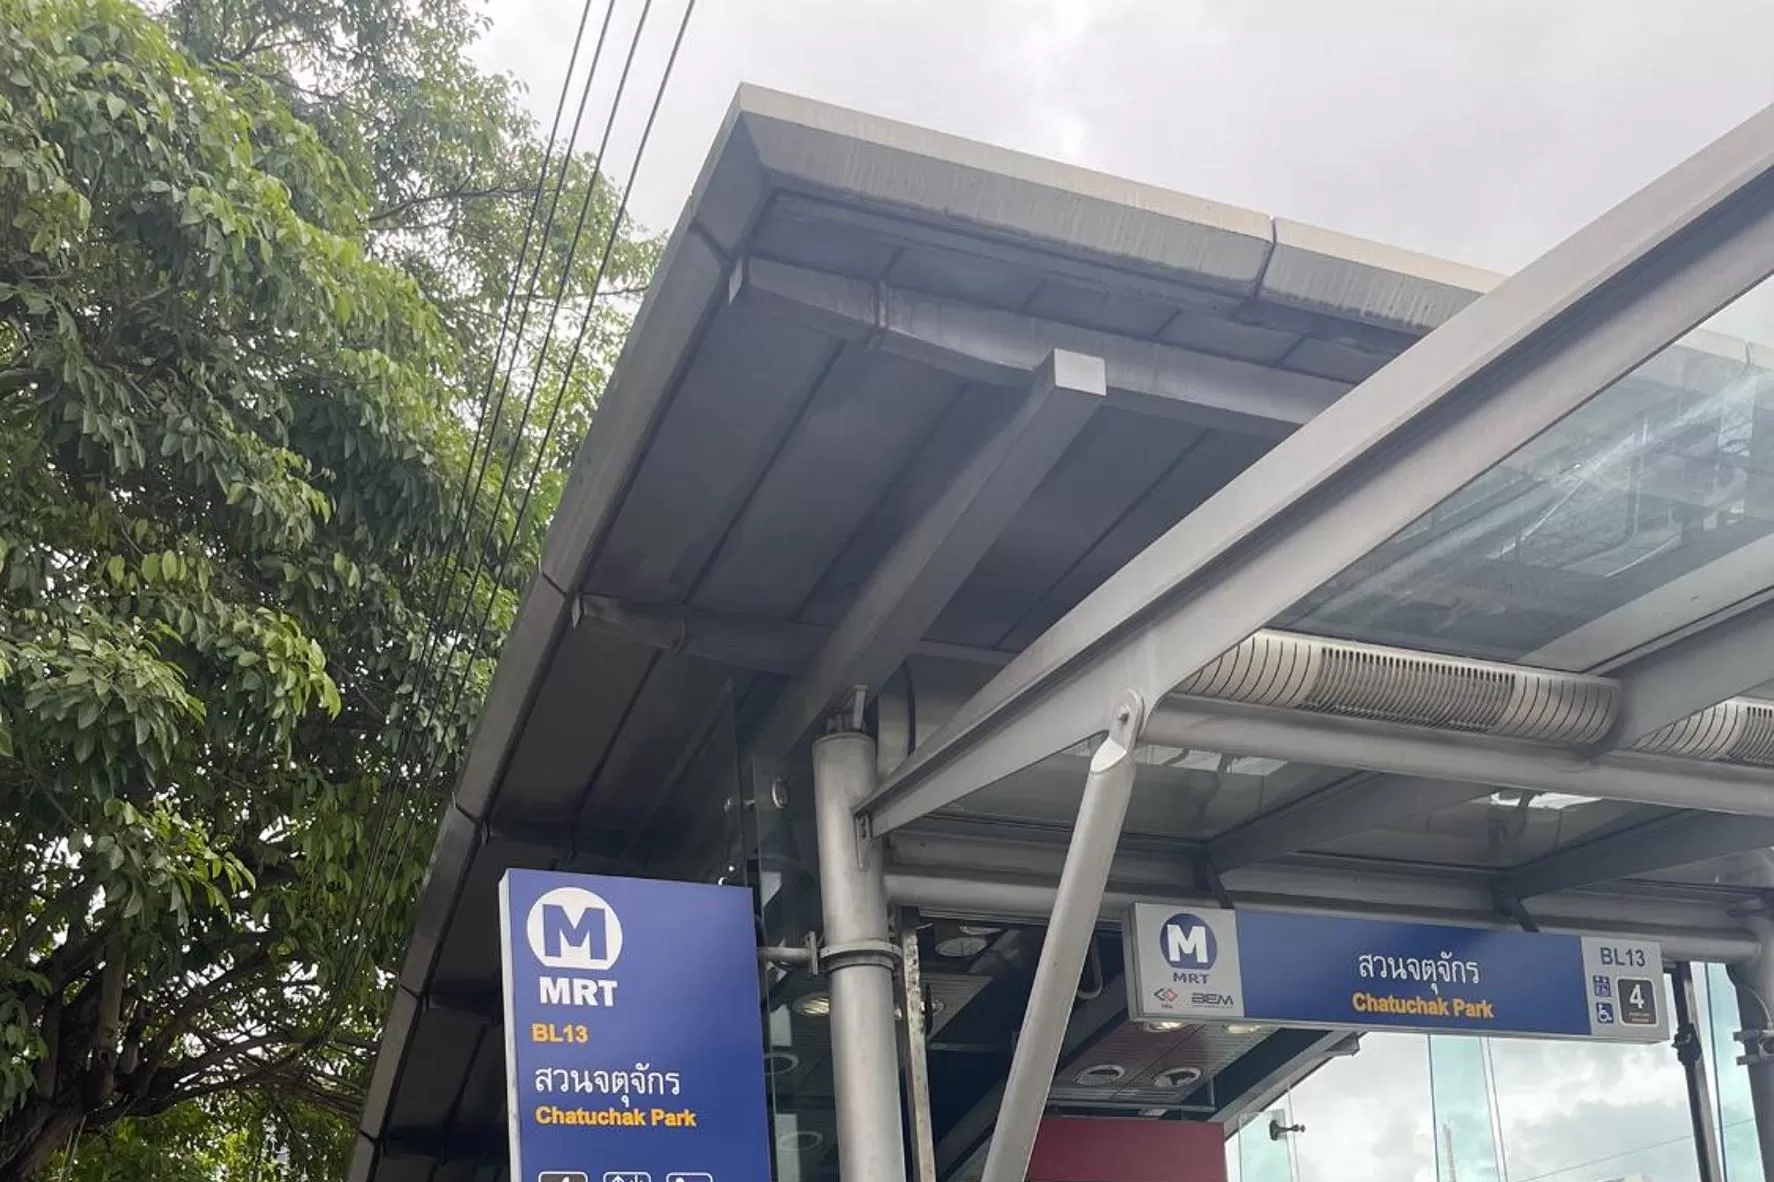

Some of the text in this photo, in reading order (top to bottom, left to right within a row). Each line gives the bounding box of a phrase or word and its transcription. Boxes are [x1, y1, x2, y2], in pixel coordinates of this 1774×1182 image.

[542, 903, 608, 961] M
[1166, 923, 1209, 964] M
[1600, 946, 1646, 968] BL13
[1172, 972, 1211, 985] MRT
[1358, 951, 1481, 995] สวนจตุจักร
[539, 976, 618, 1007] MRT
[1191, 992, 1235, 1006] BEM
[1629, 984, 1645, 1009] 4
[1352, 991, 1495, 1019] Chatuchak Park
[531, 1023, 589, 1043] BL13
[535, 1062, 680, 1108] สวนจตุจักร
[535, 1105, 697, 1127] Chatuchak Park
